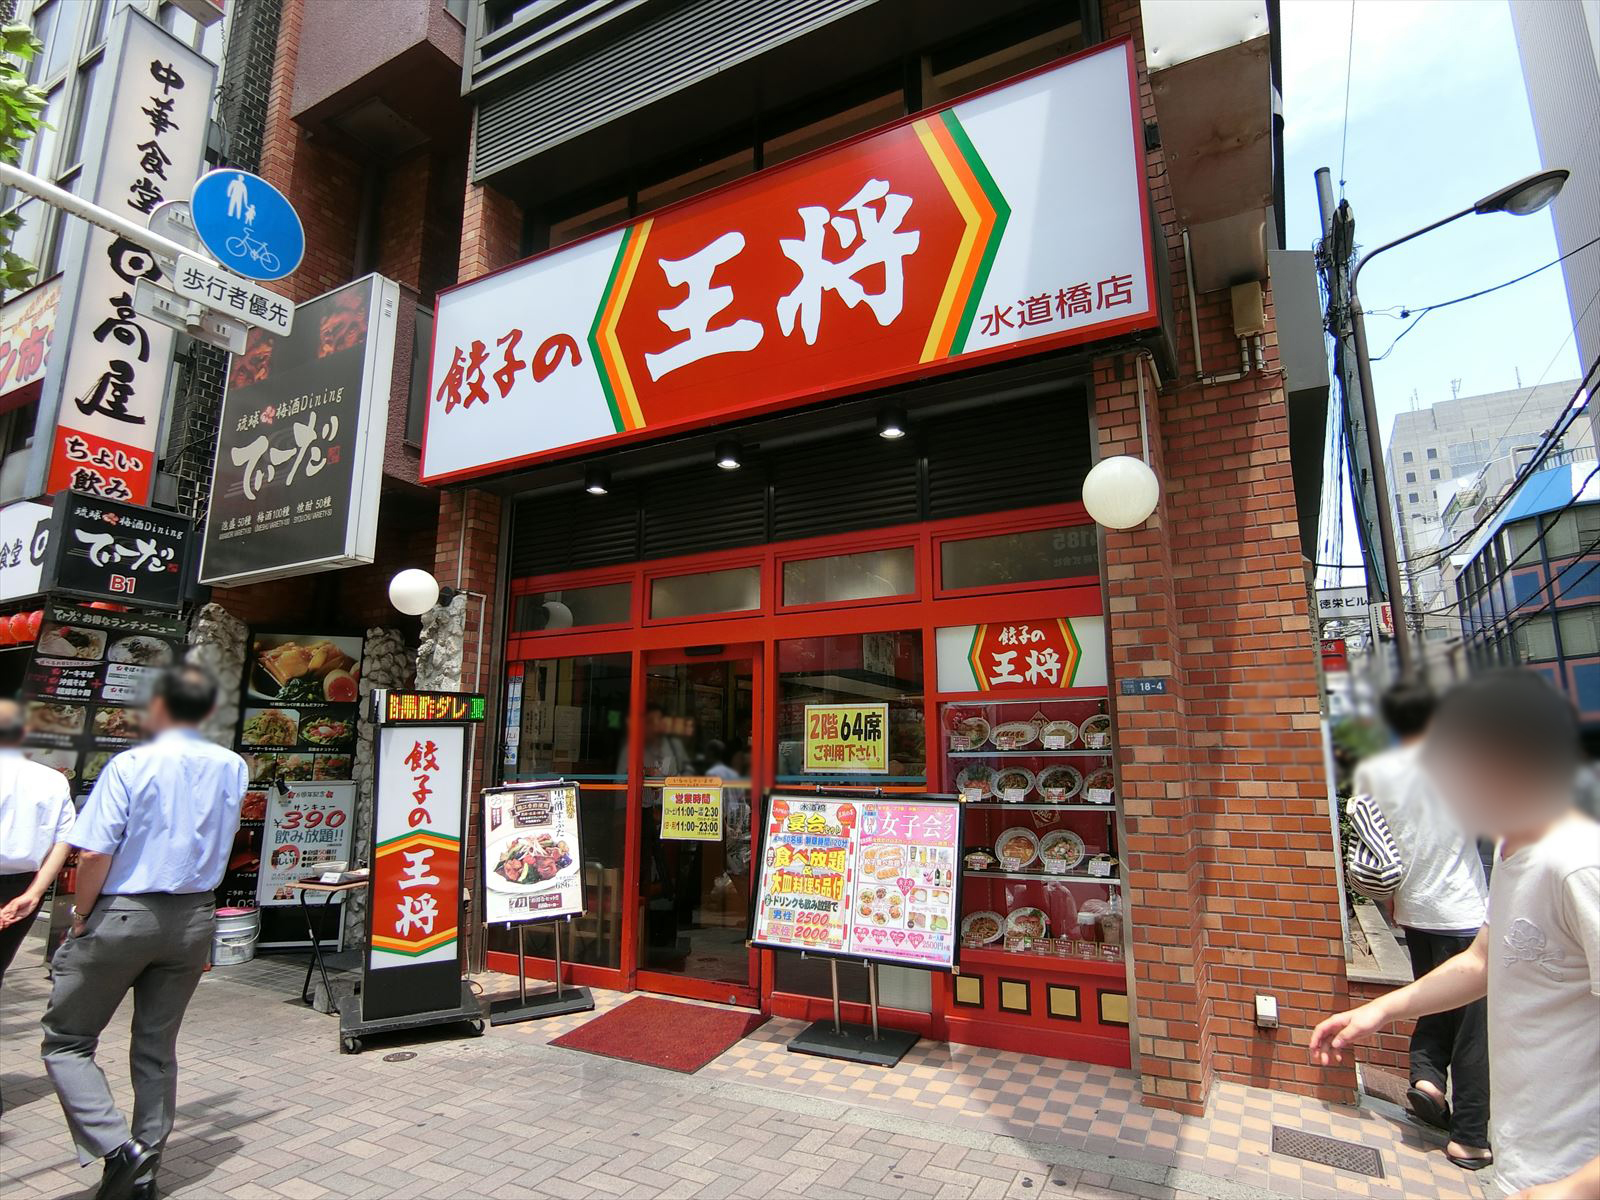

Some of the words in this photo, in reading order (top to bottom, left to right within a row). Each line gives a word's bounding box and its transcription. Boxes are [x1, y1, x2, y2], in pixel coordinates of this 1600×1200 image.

[127, 60, 185, 214] 中華食堂
[182, 267, 290, 328] 歩行者優先
[436, 328, 582, 416] 餃子の
[645, 178, 921, 382] 王将
[980, 273, 1134, 337] 水道橋店
[236, 410, 260, 432] 琉球
[66, 437, 143, 472] ちょい
[231, 411, 339, 500] てぃーだ
[72, 467, 131, 500] 飲み
[74, 507, 103, 520] 琉球
[75, 528, 175, 573] てぃーだ
[110, 574, 136, 594] B1
[1319, 597, 1367, 610] 徳栄ビル
[998, 625, 1045, 645] 餃子の
[989, 648, 1061, 685] 王将
[1140, 682, 1163, 691] 18-4
[813, 744, 881, 762] ご利用下さい。
[404, 740, 440, 828] 餃子の
[675, 793, 711, 805] 営業時間
[879, 812, 942, 839] 女子会
[774, 846, 846, 873] 食べ放題
[395, 848, 440, 937] 王将
[771, 872, 844, 900] 大皿料理5品付
[773, 910, 792, 920] 男性
[796, 911, 829, 926] 2500
[770, 925, 791, 937] 女性
[794, 926, 828, 941] 2000
